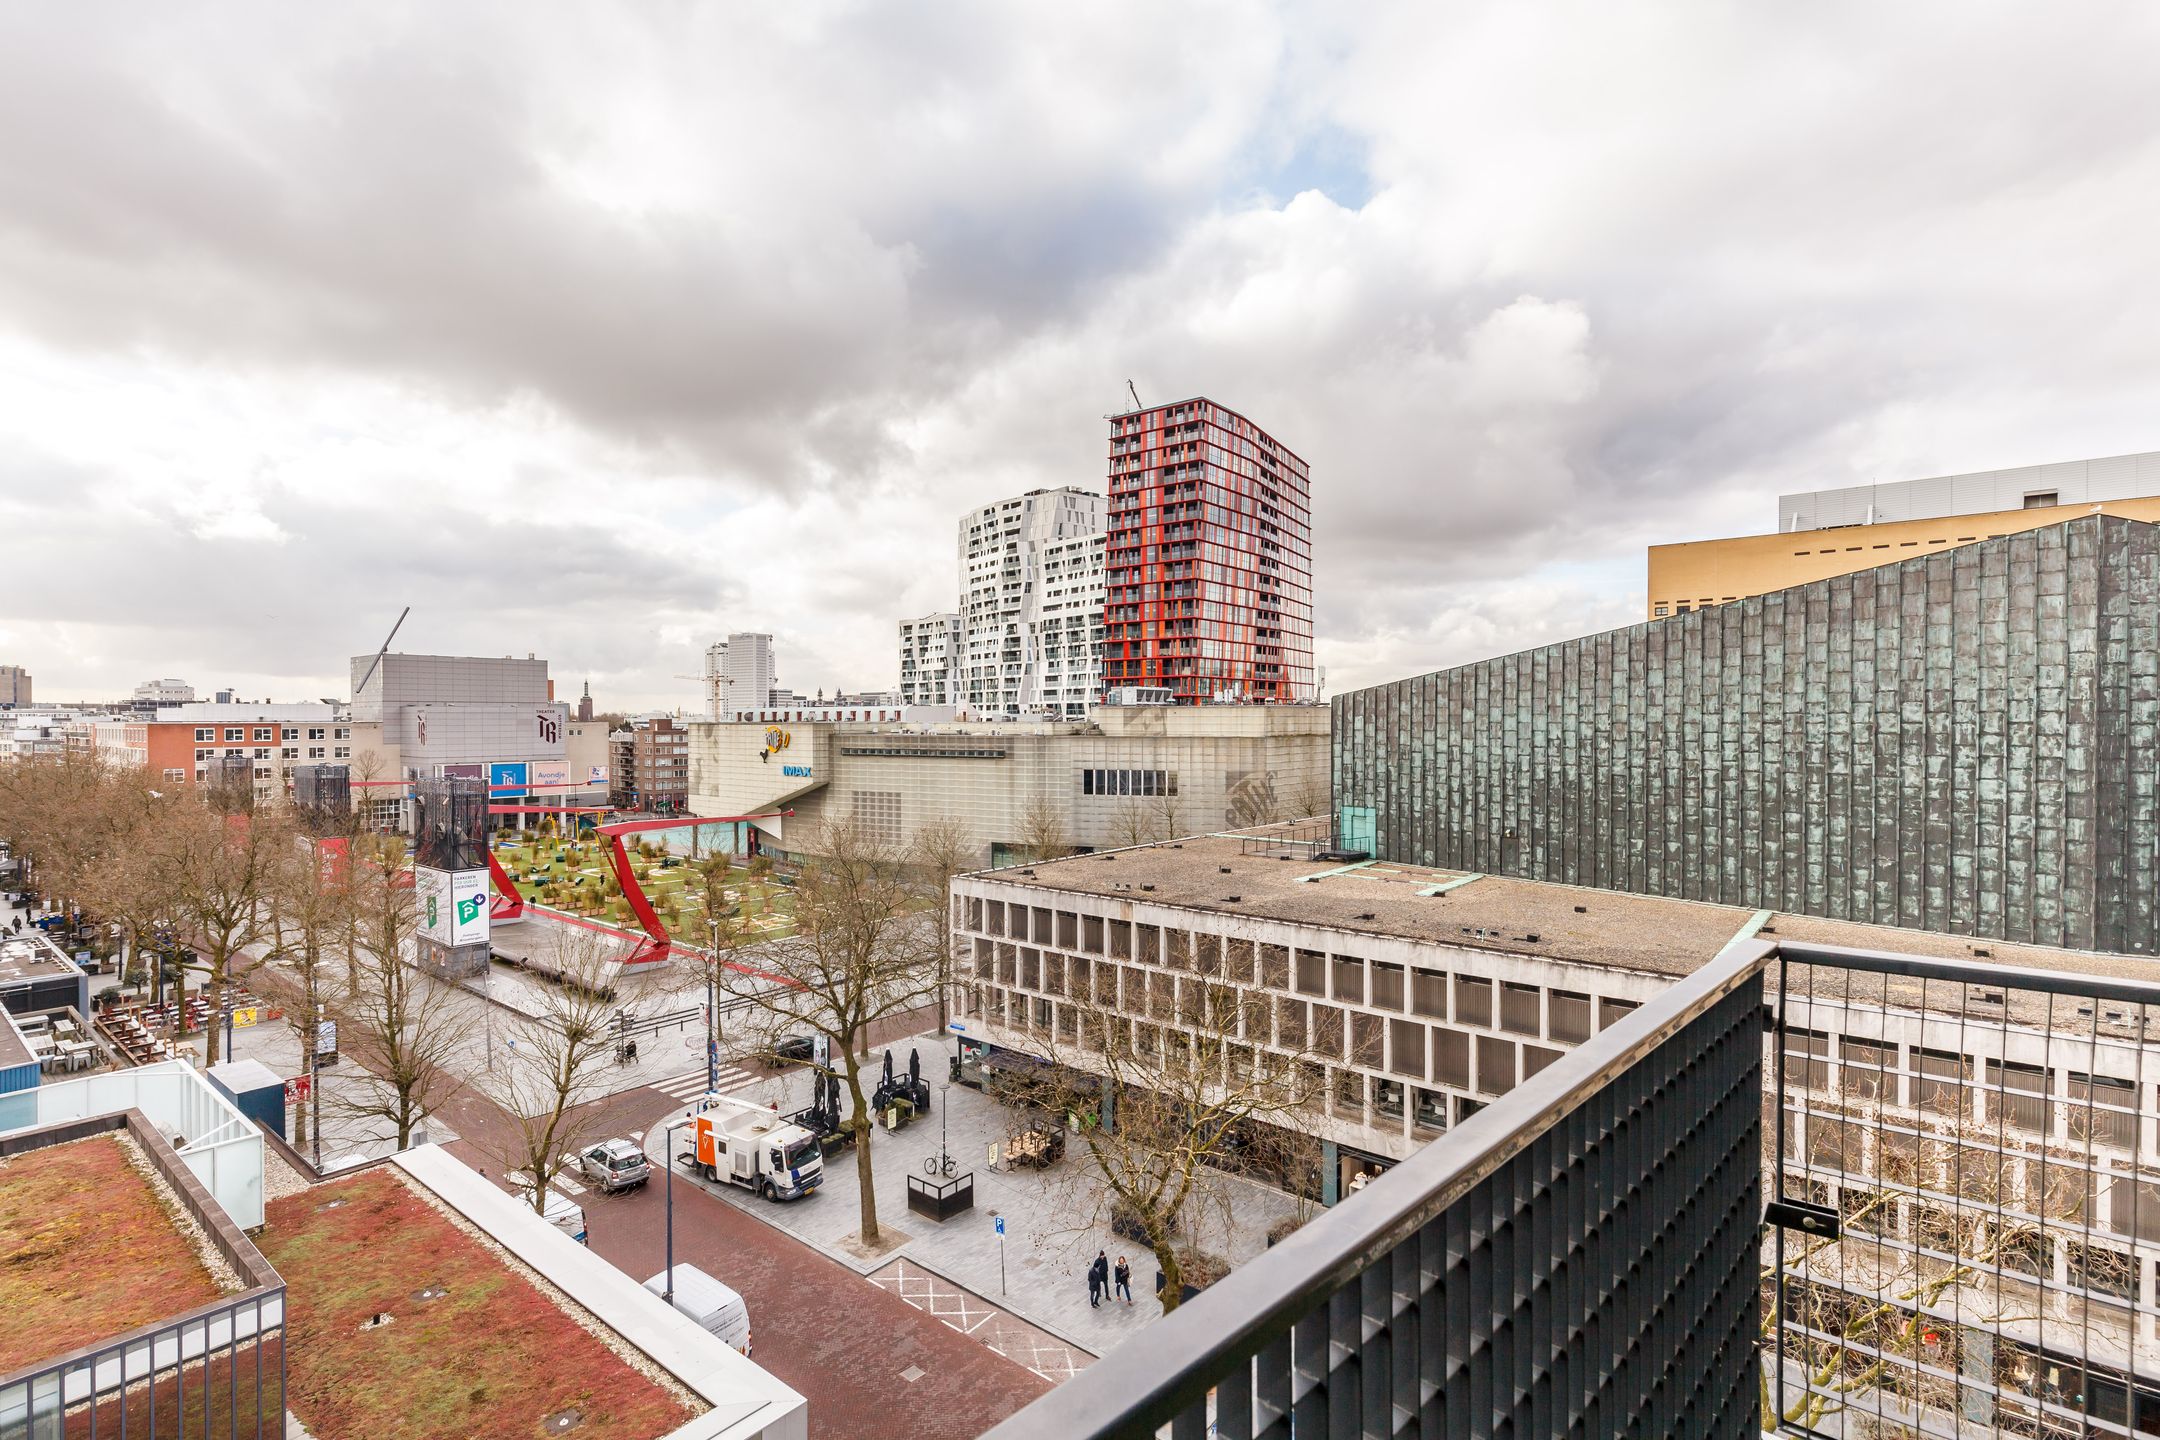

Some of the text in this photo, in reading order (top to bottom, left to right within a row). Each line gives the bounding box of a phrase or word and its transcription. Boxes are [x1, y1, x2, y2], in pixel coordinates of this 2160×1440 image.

[536, 714, 557, 744] TR
[537, 771, 565, 780] Avondje
[783, 765, 812, 777] IMAX
[464, 906, 474, 918] P
